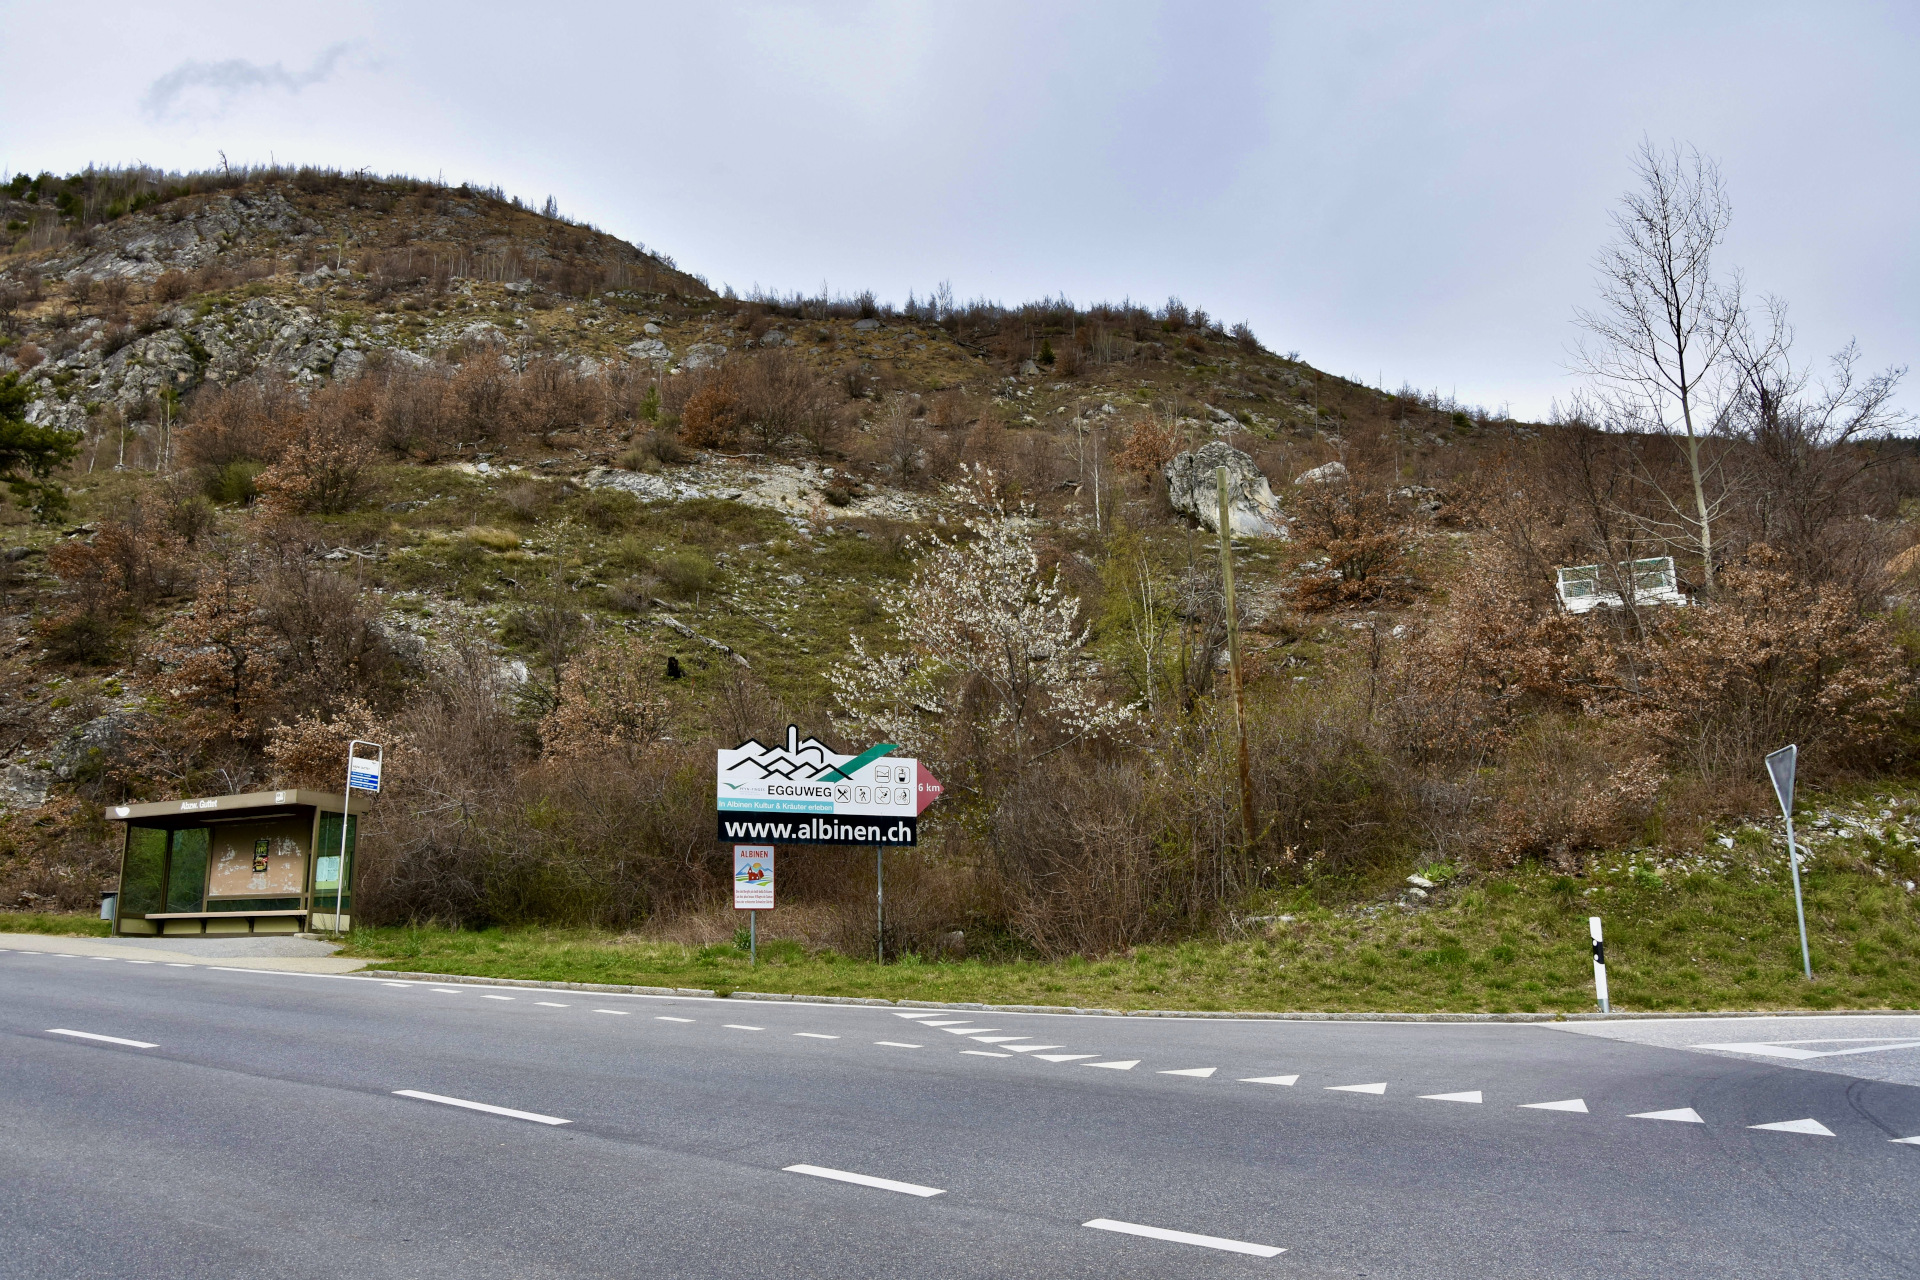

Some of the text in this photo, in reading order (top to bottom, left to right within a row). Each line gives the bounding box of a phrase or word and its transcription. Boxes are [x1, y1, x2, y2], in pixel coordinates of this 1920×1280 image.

[767, 785, 832, 797] EGGUWEG
[918, 783, 940, 792] 6 km
[181, 800, 218, 811] Abzw. Guttet
[782, 802, 807, 810] Kräuter
[725, 818, 912, 842] www.albinen.ch
[740, 850, 769, 858] ALBINEN
